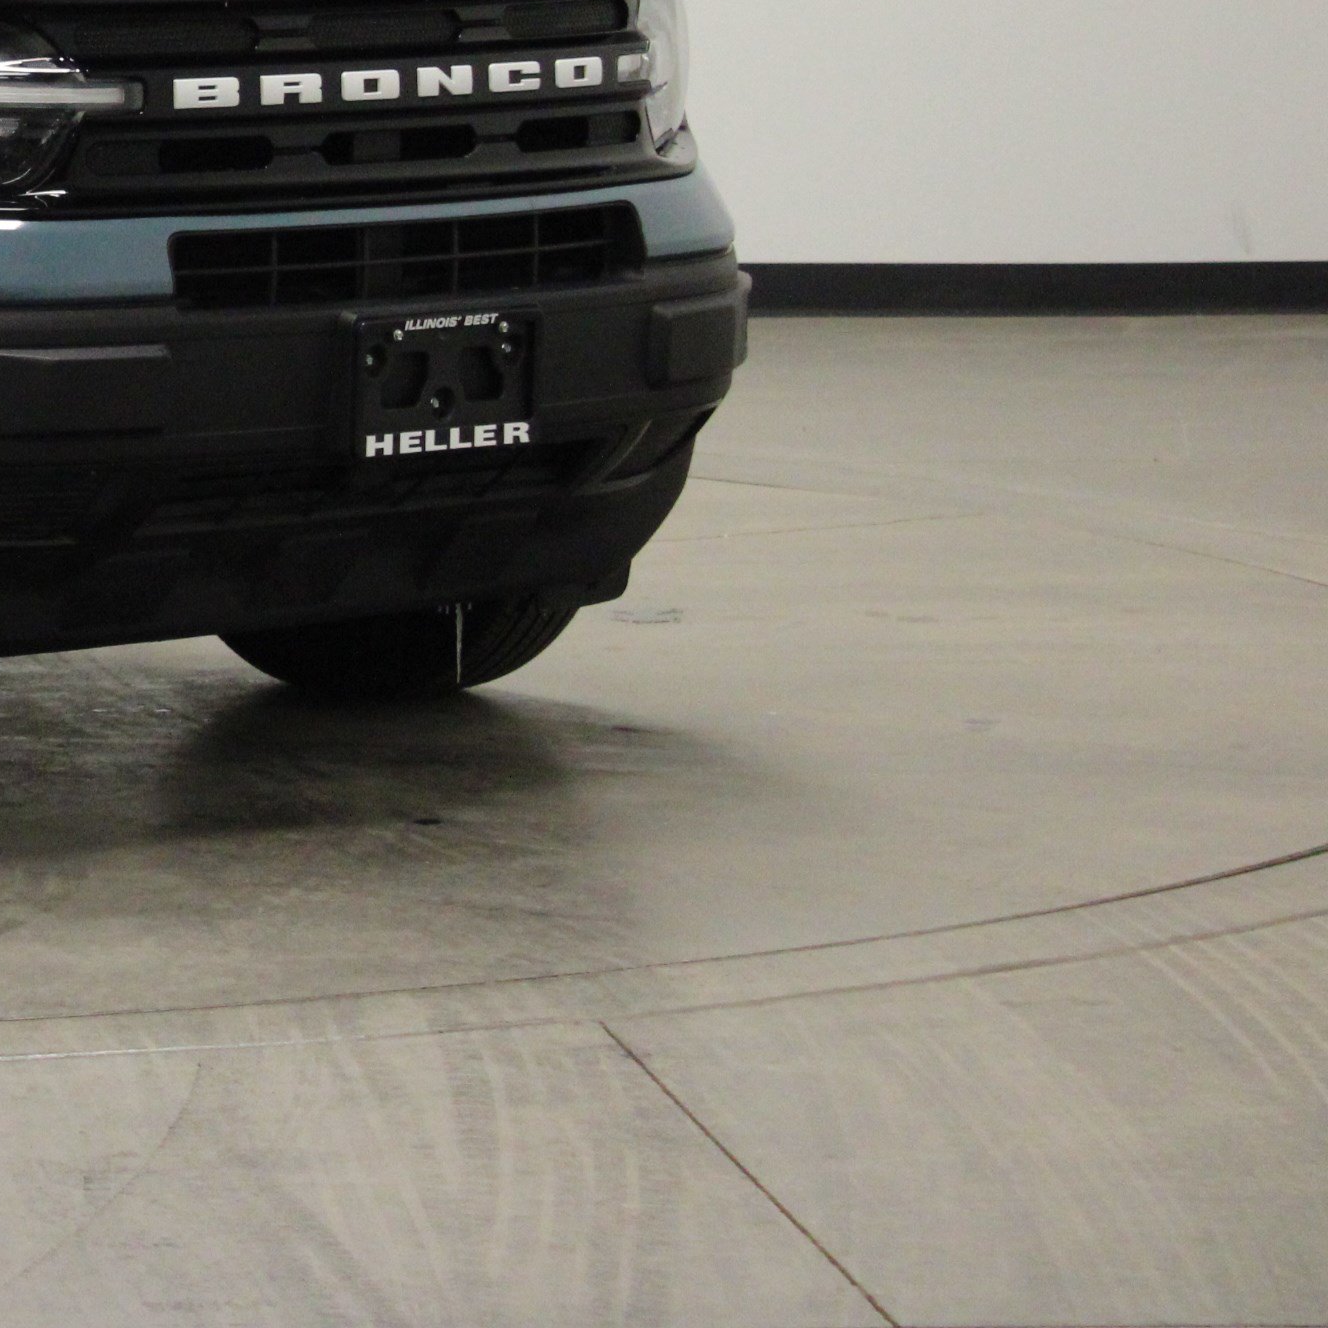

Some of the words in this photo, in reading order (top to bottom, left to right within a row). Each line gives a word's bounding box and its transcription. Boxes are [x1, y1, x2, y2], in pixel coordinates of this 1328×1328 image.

[172, 56, 603, 110] BRONCO
[404, 316, 461, 332] ILLINOIS'
[464, 312, 499, 327] BEST
[365, 422, 531, 458] HELLER
